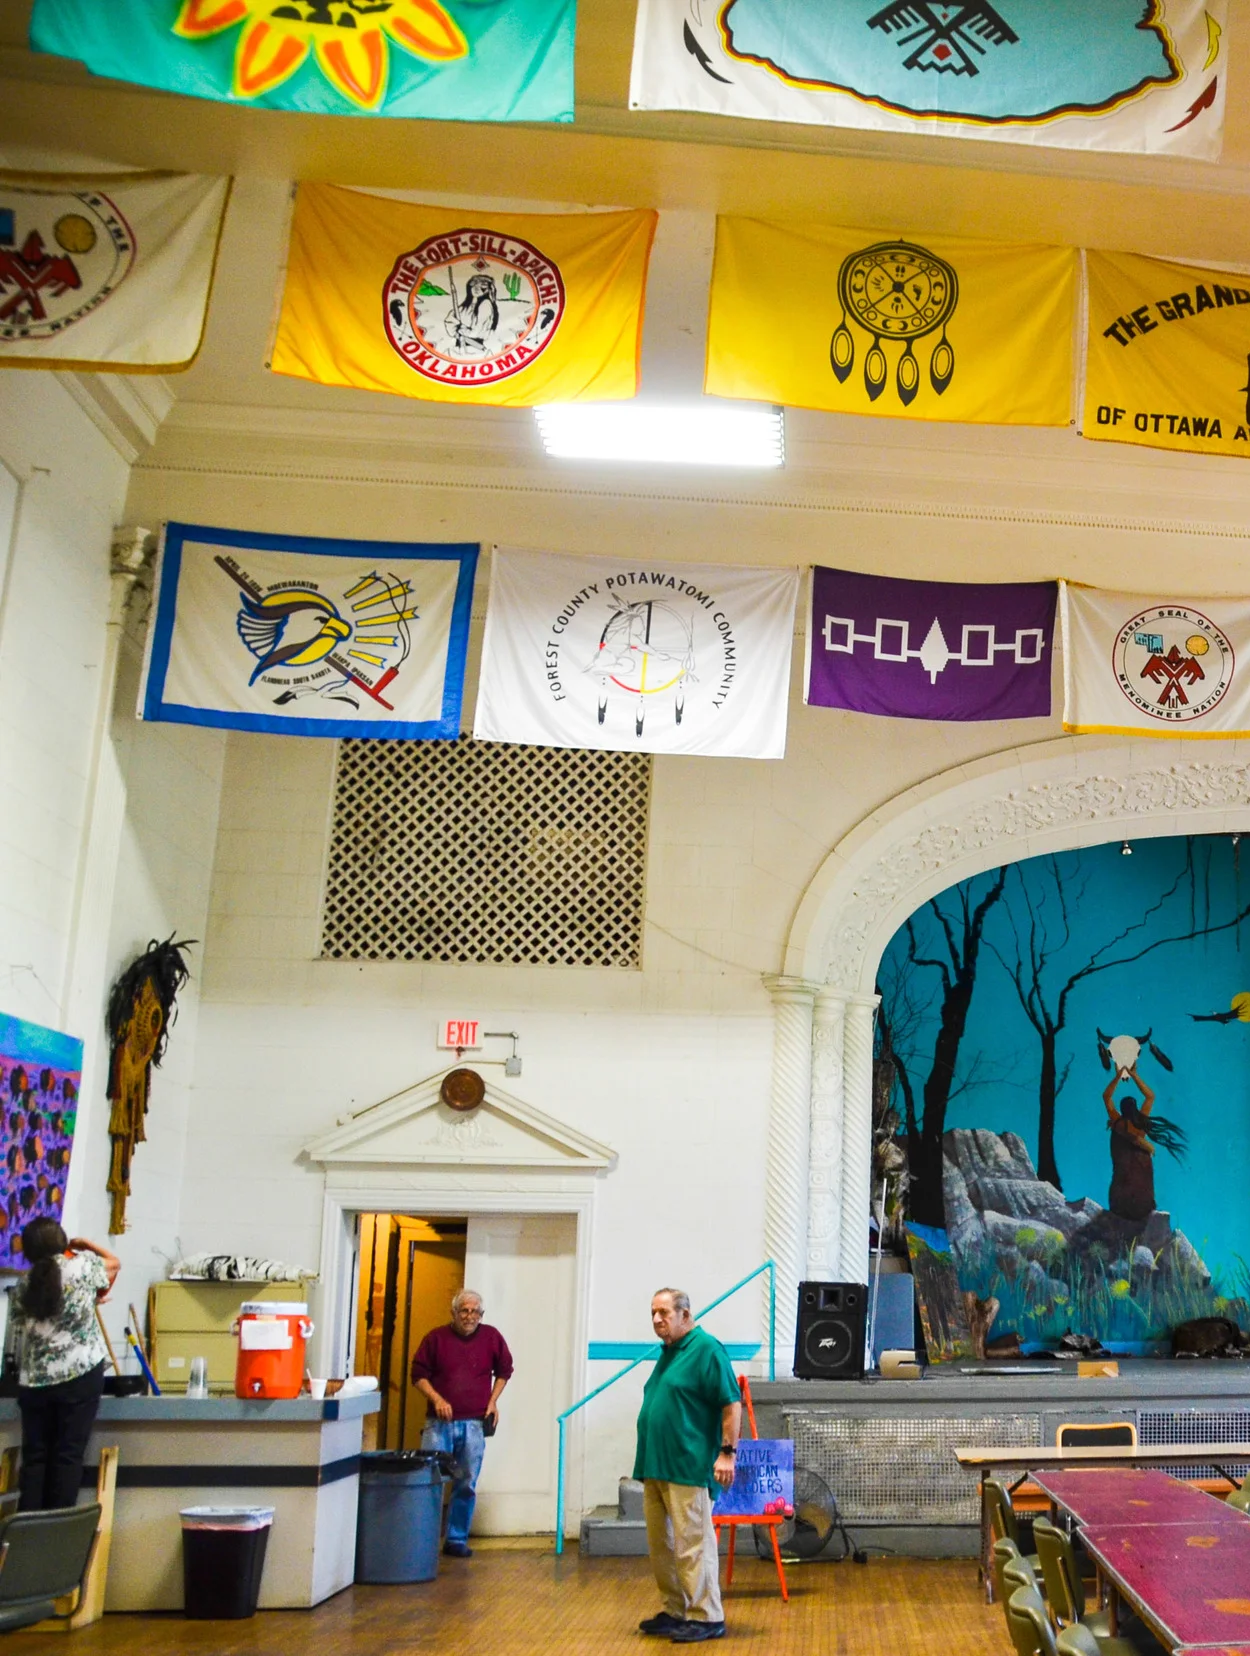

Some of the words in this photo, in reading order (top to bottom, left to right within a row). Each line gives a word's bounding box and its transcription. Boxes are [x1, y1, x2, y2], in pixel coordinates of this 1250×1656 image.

[391, 260, 420, 295] THE
[1103, 305, 1159, 348] THE
[402, 340, 534, 379] OKLAHOMA
[1096, 405, 1127, 426] OF
[1134, 412, 1223, 439] OTTAWA
[552, 583, 600, 635] COUNTY
[605, 572, 716, 610] POTAWATOMI
[1120, 616, 1146, 644] GREAT
[1158, 609, 1188, 618] SEAL
[1197, 619, 1211, 631] OF
[1214, 633, 1229, 653] THE
[292, 674, 310, 684] SOUTH
[546, 640, 566, 702] FOREST
[711, 612, 736, 709] COMMUNITY
[1119, 673, 1182, 719] MENOMINEE
[1192, 681, 1226, 715] NATION
[447, 1021, 479, 1046] EXIT
